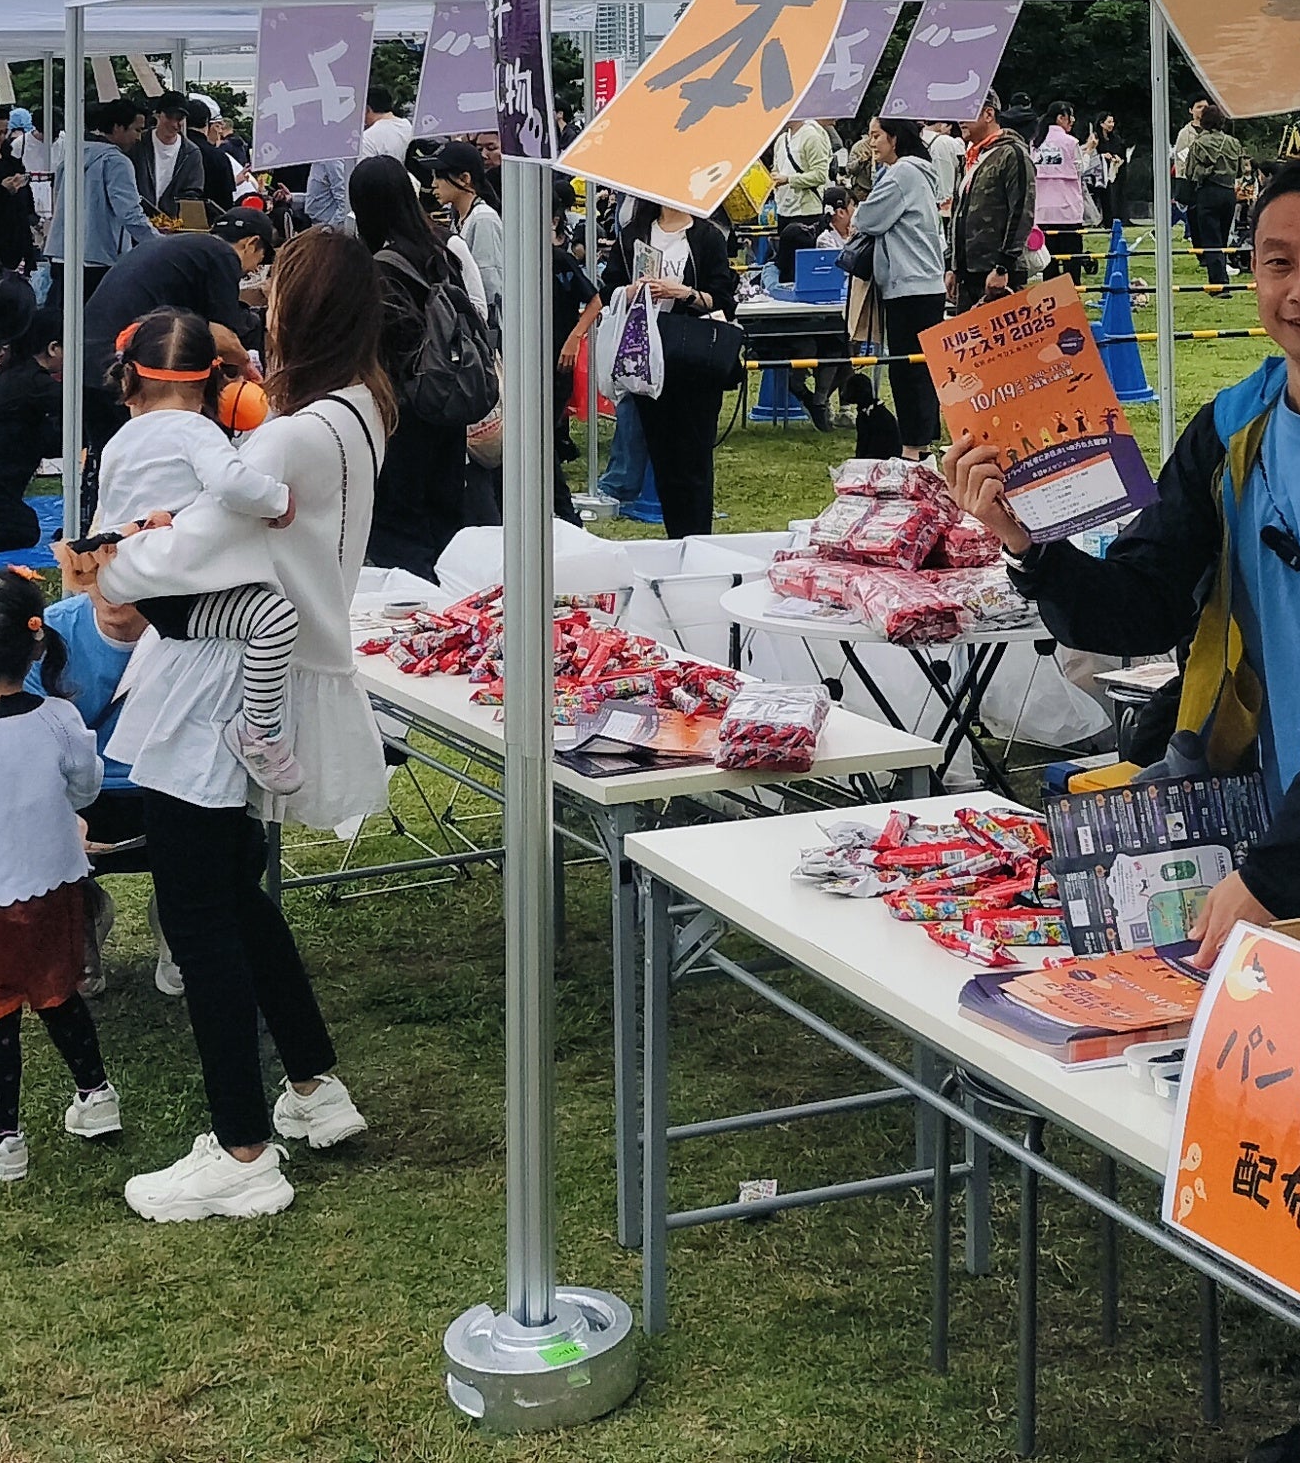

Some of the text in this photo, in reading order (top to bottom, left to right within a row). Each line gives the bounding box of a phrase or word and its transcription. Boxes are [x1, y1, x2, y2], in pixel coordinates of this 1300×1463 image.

[953, 332, 1007, 364] フェスタ
[1009, 312, 1057, 342] 2025
[970, 382, 1017, 413] 10/19
